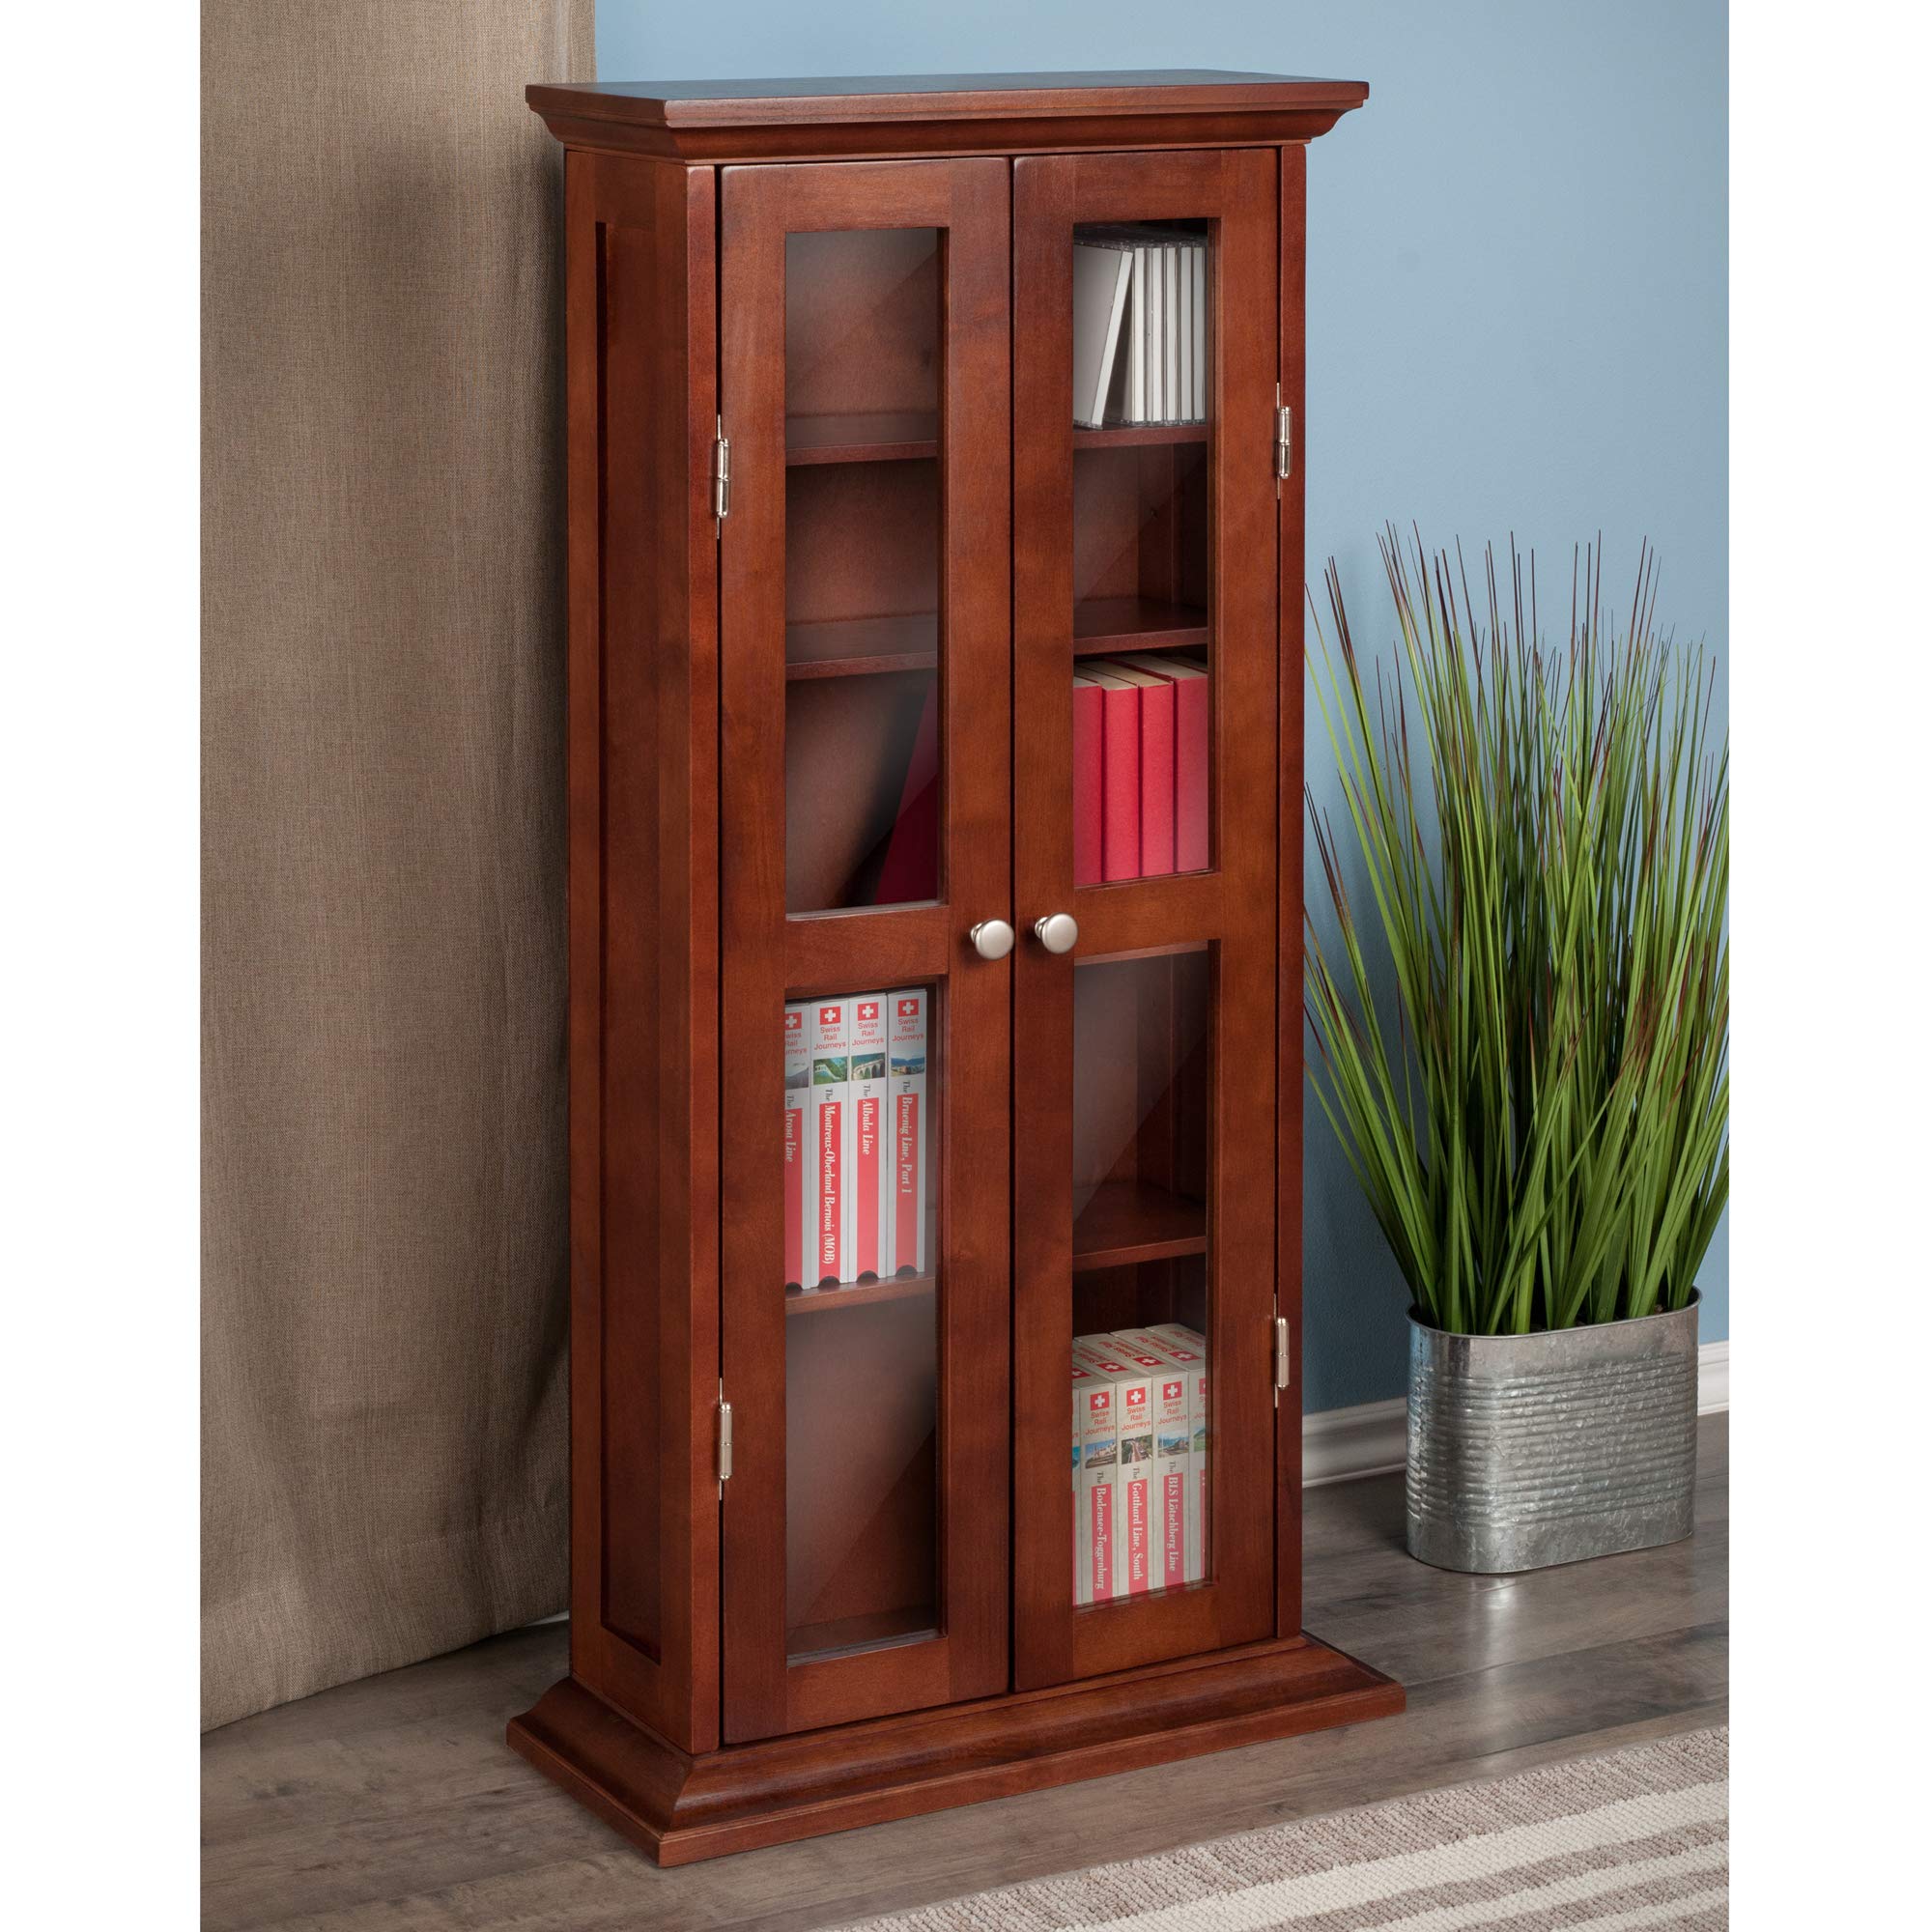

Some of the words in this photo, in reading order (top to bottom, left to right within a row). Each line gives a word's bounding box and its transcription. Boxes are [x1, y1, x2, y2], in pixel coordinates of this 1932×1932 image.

[814, 1041, 846, 1051] Journeys
[852, 1037, 884, 1047] Journeys
[892, 1034, 924, 1042] Journeys
[786, 1094, 795, 1107] The
[863, 1084, 871, 1097] The
[785, 1111, 796, 1139] Arosa
[863, 1100, 873, 1131] Albula
[899, 1096, 913, 1134] Bruenig
[785, 1141, 797, 1162] Line
[824, 1105, 836, 1194] Montreux-Oberland
[863, 1134, 873, 1155] Line
[900, 1137, 913, 1161] Line,
[901, 1163, 913, 1184] Part
[824, 1196, 836, 1231] Bernois
[823, 1234, 836, 1264] (MOB)
[1085, 1426, 1115, 1435] Journeys
[1122, 1420, 1151, 1431] Journeys
[1158, 1414, 1187, 1425] Journeys
[1168, 1476, 1179, 1496] BLS
[1132, 1483, 1143, 1524] Gotthard
[1167, 1498, 1179, 1548] Lötschberg
[1095, 1488, 1107, 1589] Bodensee-Toggenburg
[1131, 1527, 1143, 1550] Line,
[1132, 1552, 1144, 1580] South
[1168, 1550, 1179, 1572] Line
